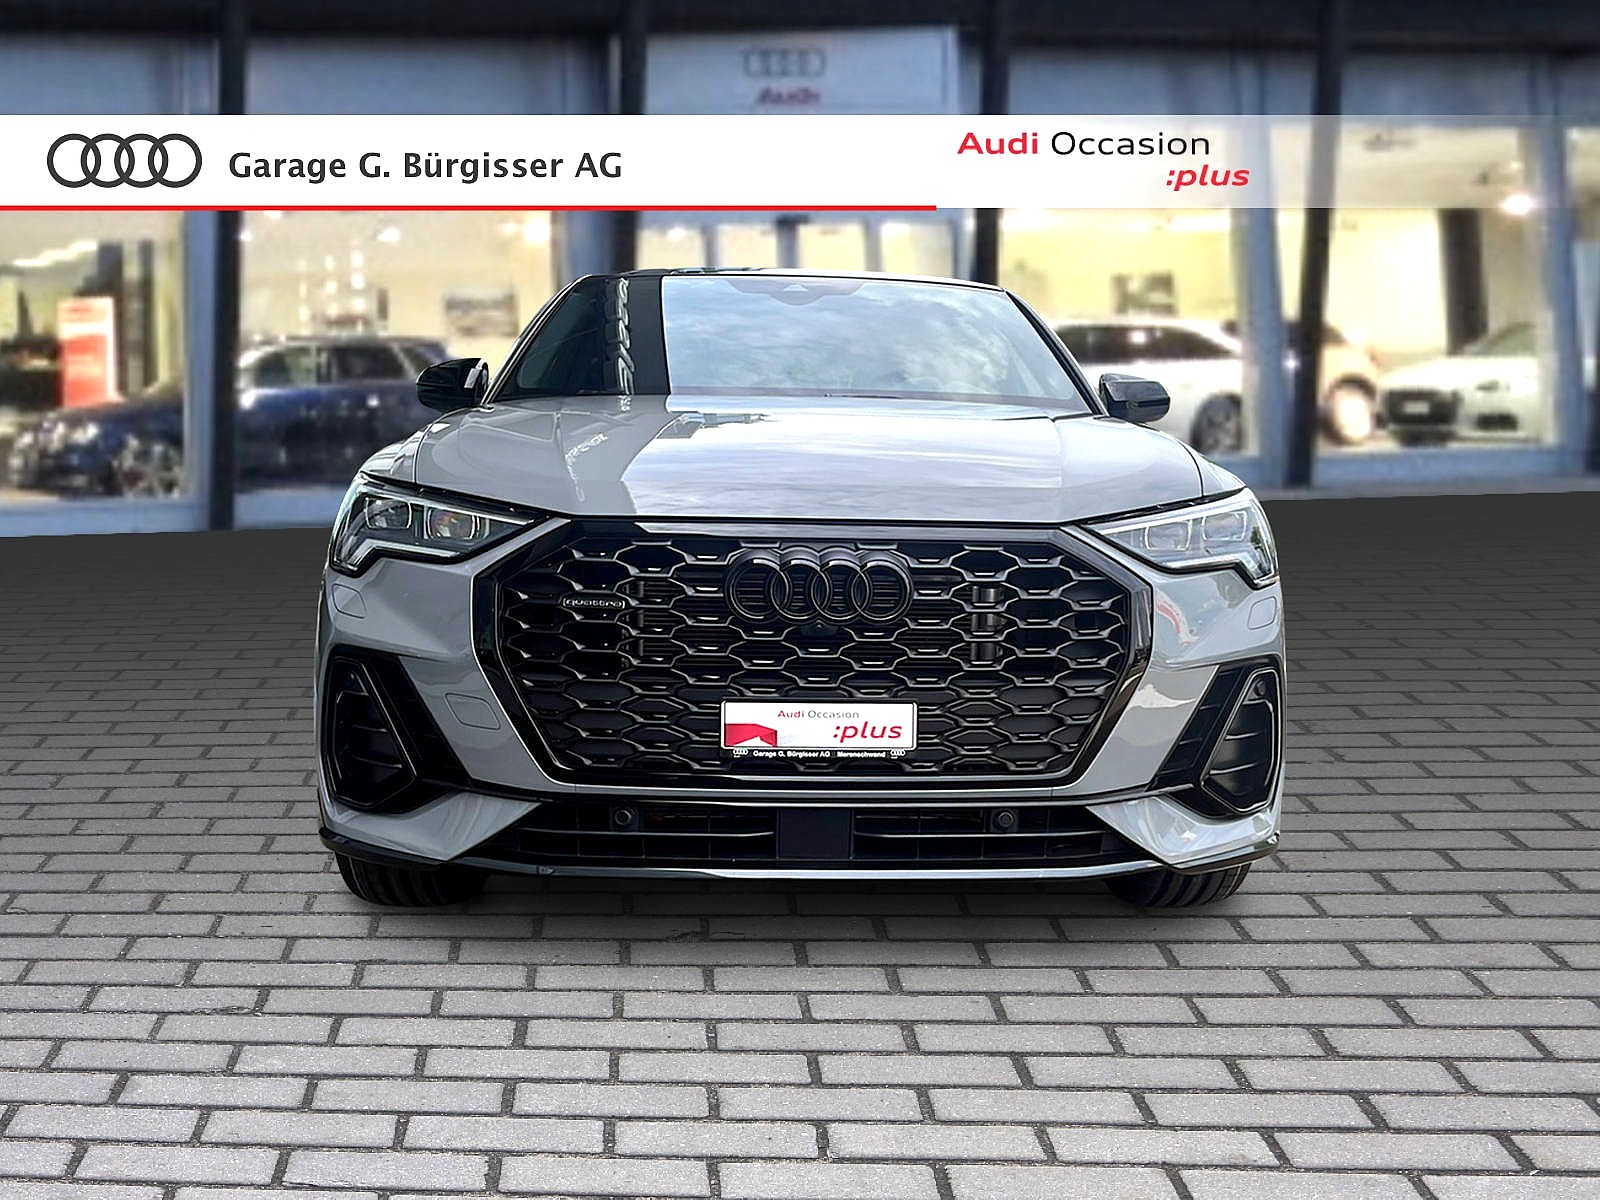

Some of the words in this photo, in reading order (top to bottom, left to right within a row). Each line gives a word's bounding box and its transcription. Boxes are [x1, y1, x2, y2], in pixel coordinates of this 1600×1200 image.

[565, 599, 623, 607] quattro
[777, 710, 805, 719] Audi
[807, 709, 860, 719] Occasion
[833, 721, 903, 743] :plus
